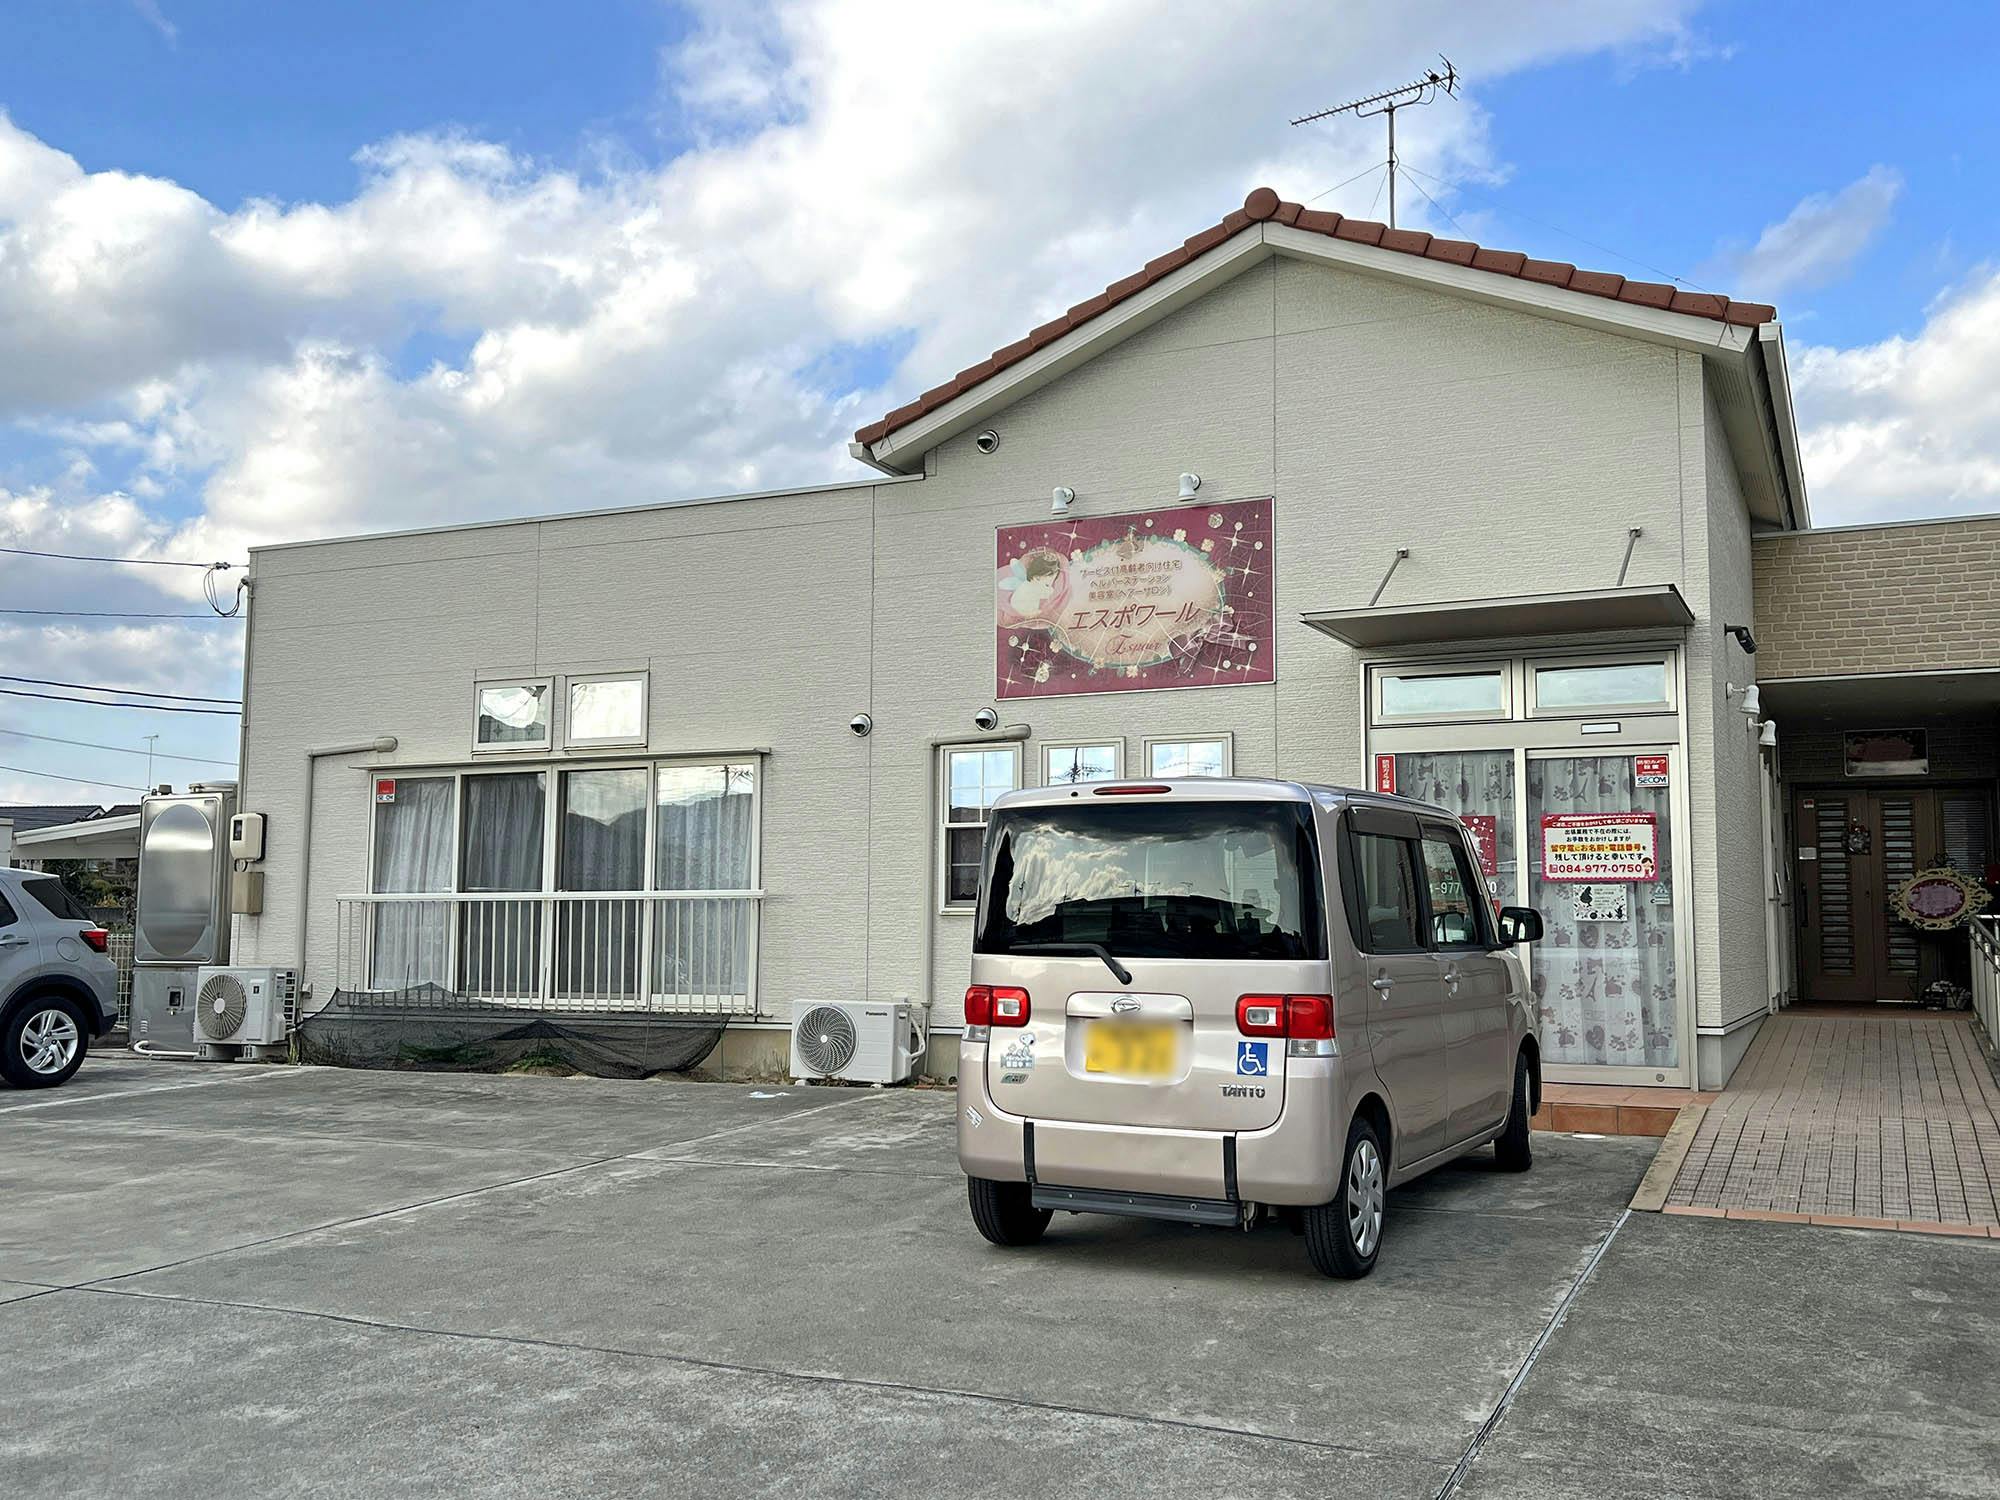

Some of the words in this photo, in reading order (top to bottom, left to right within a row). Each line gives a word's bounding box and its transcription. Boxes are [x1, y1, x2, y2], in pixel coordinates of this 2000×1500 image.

[1090, 574, 1170, 588] ヘルパーステーション
[1068, 602, 1201, 630] エスポワール
[1559, 864, 1642, 873] 084-977-0750
[1218, 1084, 1266, 1098] TANTO
